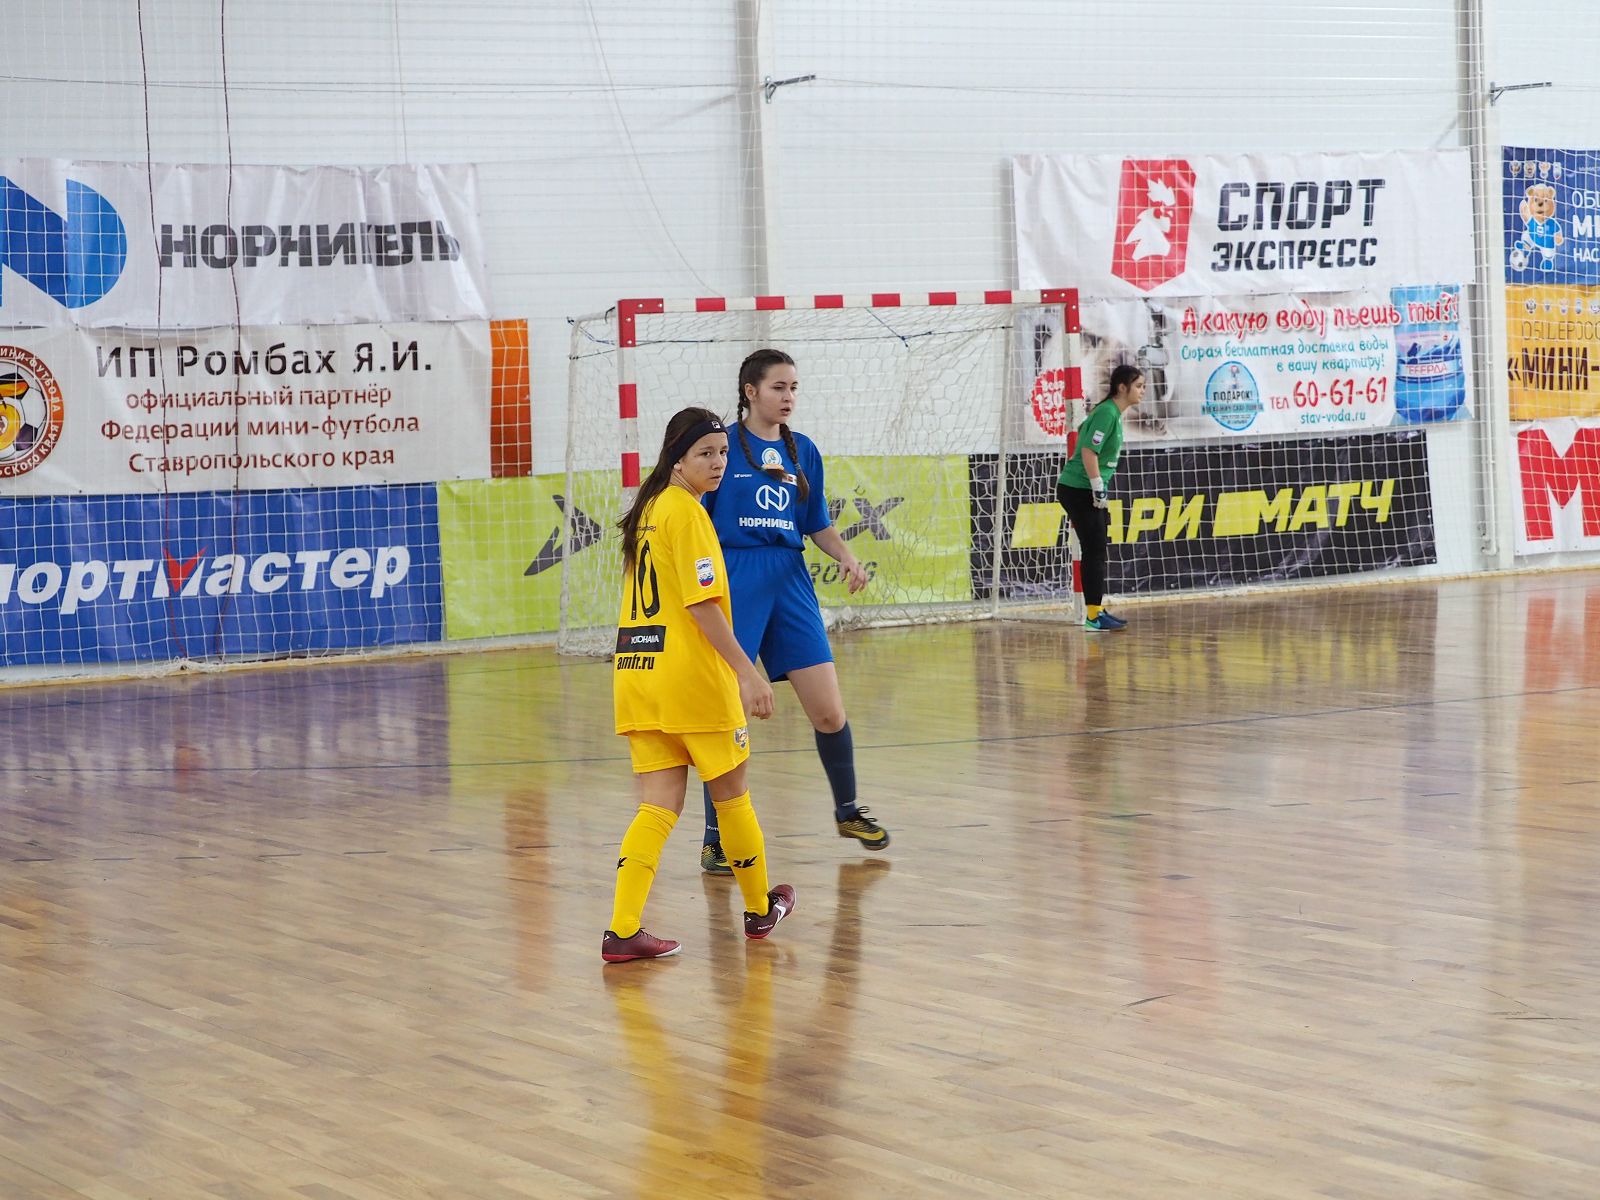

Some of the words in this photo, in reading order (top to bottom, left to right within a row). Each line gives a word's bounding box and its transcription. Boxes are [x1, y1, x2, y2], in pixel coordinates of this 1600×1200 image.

[1217, 179, 1386, 231] СПОРТ
[1572, 190, 1600, 208] ОБ
[1211, 238, 1378, 272] ЭКСПРЕСС
[1182, 306, 1197, 334] А
[1201, 312, 1268, 339] какую
[1276, 300, 1325, 335] воду
[1333, 304, 1400, 328] пьешь
[1408, 291, 1459, 322] ты?!
[96, 346, 156, 377] ИП
[177, 342, 336, 376] Ромбах
[353, 340, 432, 373] Я.И.
[1298, 338, 1355, 354] доставка
[1360, 334, 1388, 351] воды
[1276, 361, 1284, 373] в
[1288, 360, 1317, 374] вашу
[1322, 352, 1385, 372] квартиру!
[126, 385, 293, 414] официальный
[299, 382, 392, 409] партнёр
[1270, 396, 1290, 410] ТЕЛ
[1293, 376, 1387, 408] 60-61-61
[101, 418, 239, 444] Федерации
[247, 413, 420, 440] мини-футбола
[1300, 408, 1366, 424] stav-voda.ru
[129, 449, 335, 475] Ставропольского
[342, 448, 395, 471] края
[1247, 479, 1396, 537] МАТЧ
[631, 540, 661, 620] 10
[617, 654, 656, 670] amfr.ru
